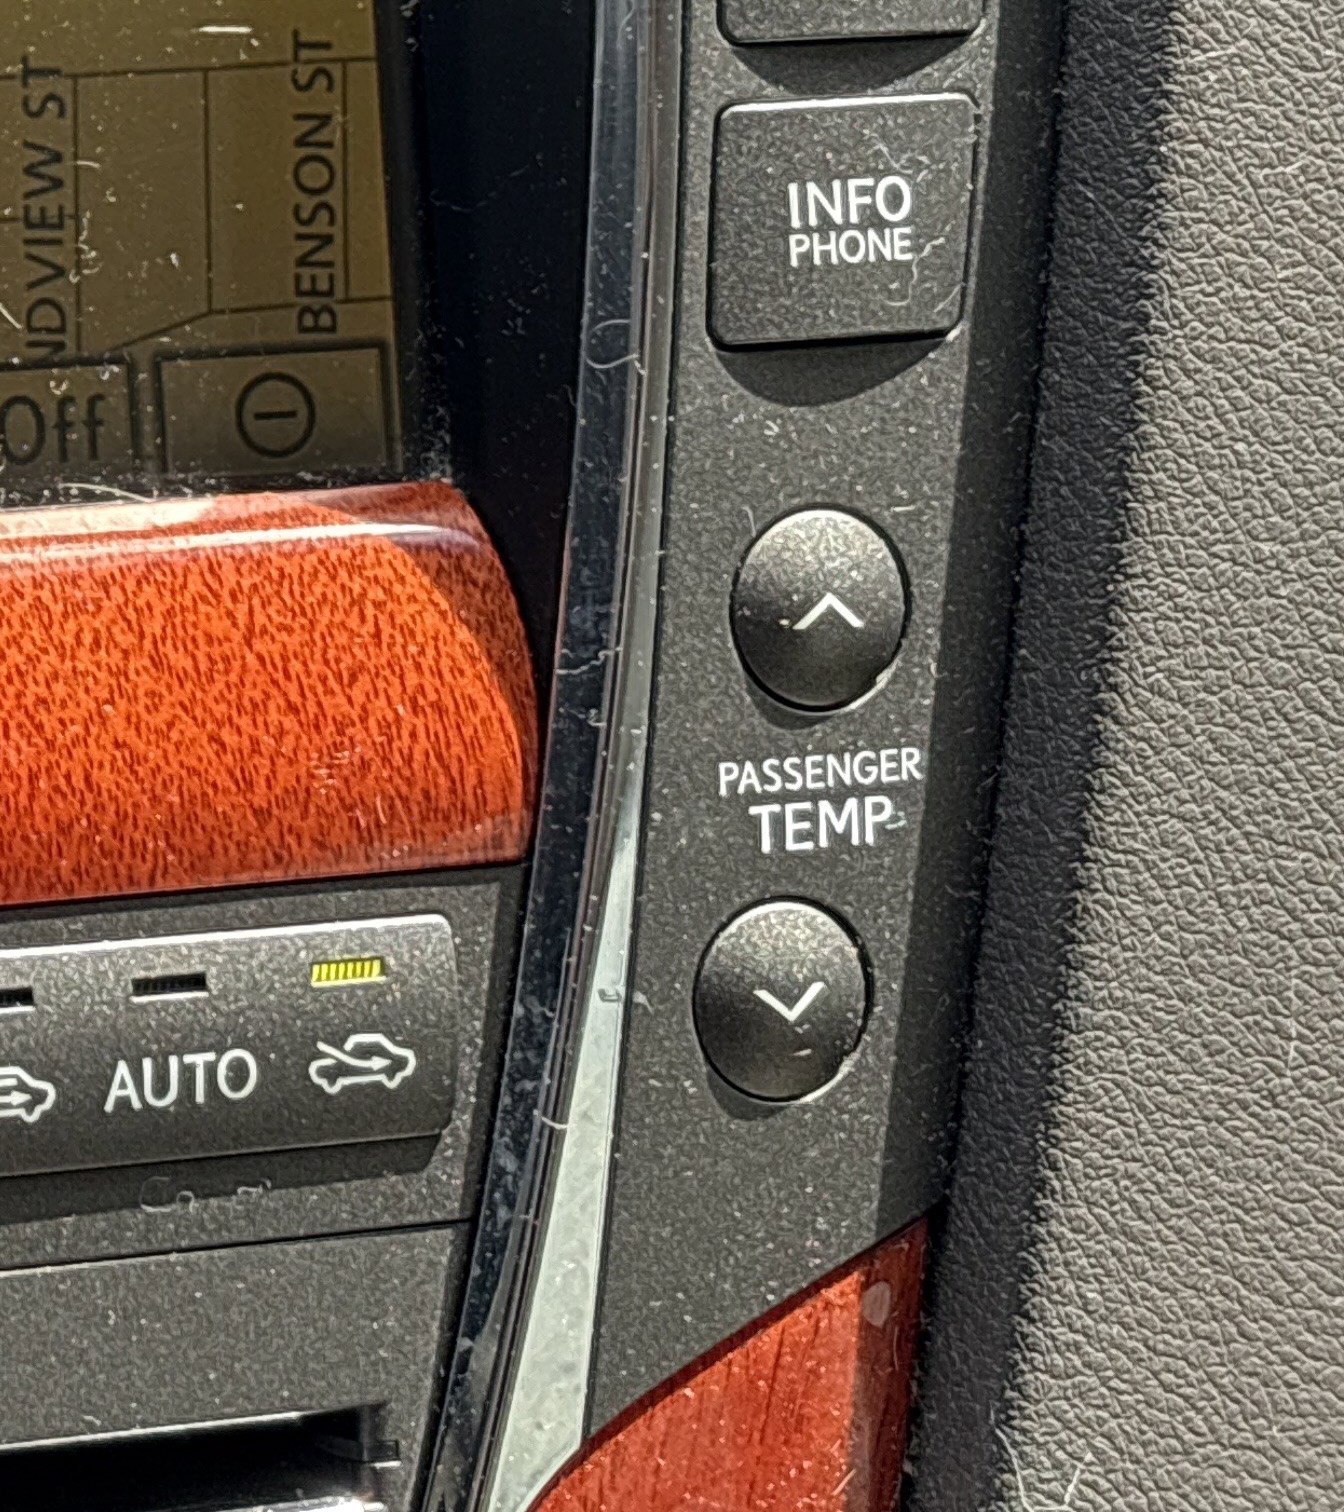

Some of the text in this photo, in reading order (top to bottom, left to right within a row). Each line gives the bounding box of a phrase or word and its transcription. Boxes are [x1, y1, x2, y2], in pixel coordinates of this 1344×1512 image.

[21, 55, 66, 120] ST
[292, 29, 338, 336] BENSON ST
[787, 176, 913, 228] INFO
[788, 227, 914, 268] PHONE
[718, 747, 923, 797] PASSENGER
[748, 795, 893, 854] TEMP
[103, 1048, 258, 1114] AUTO
